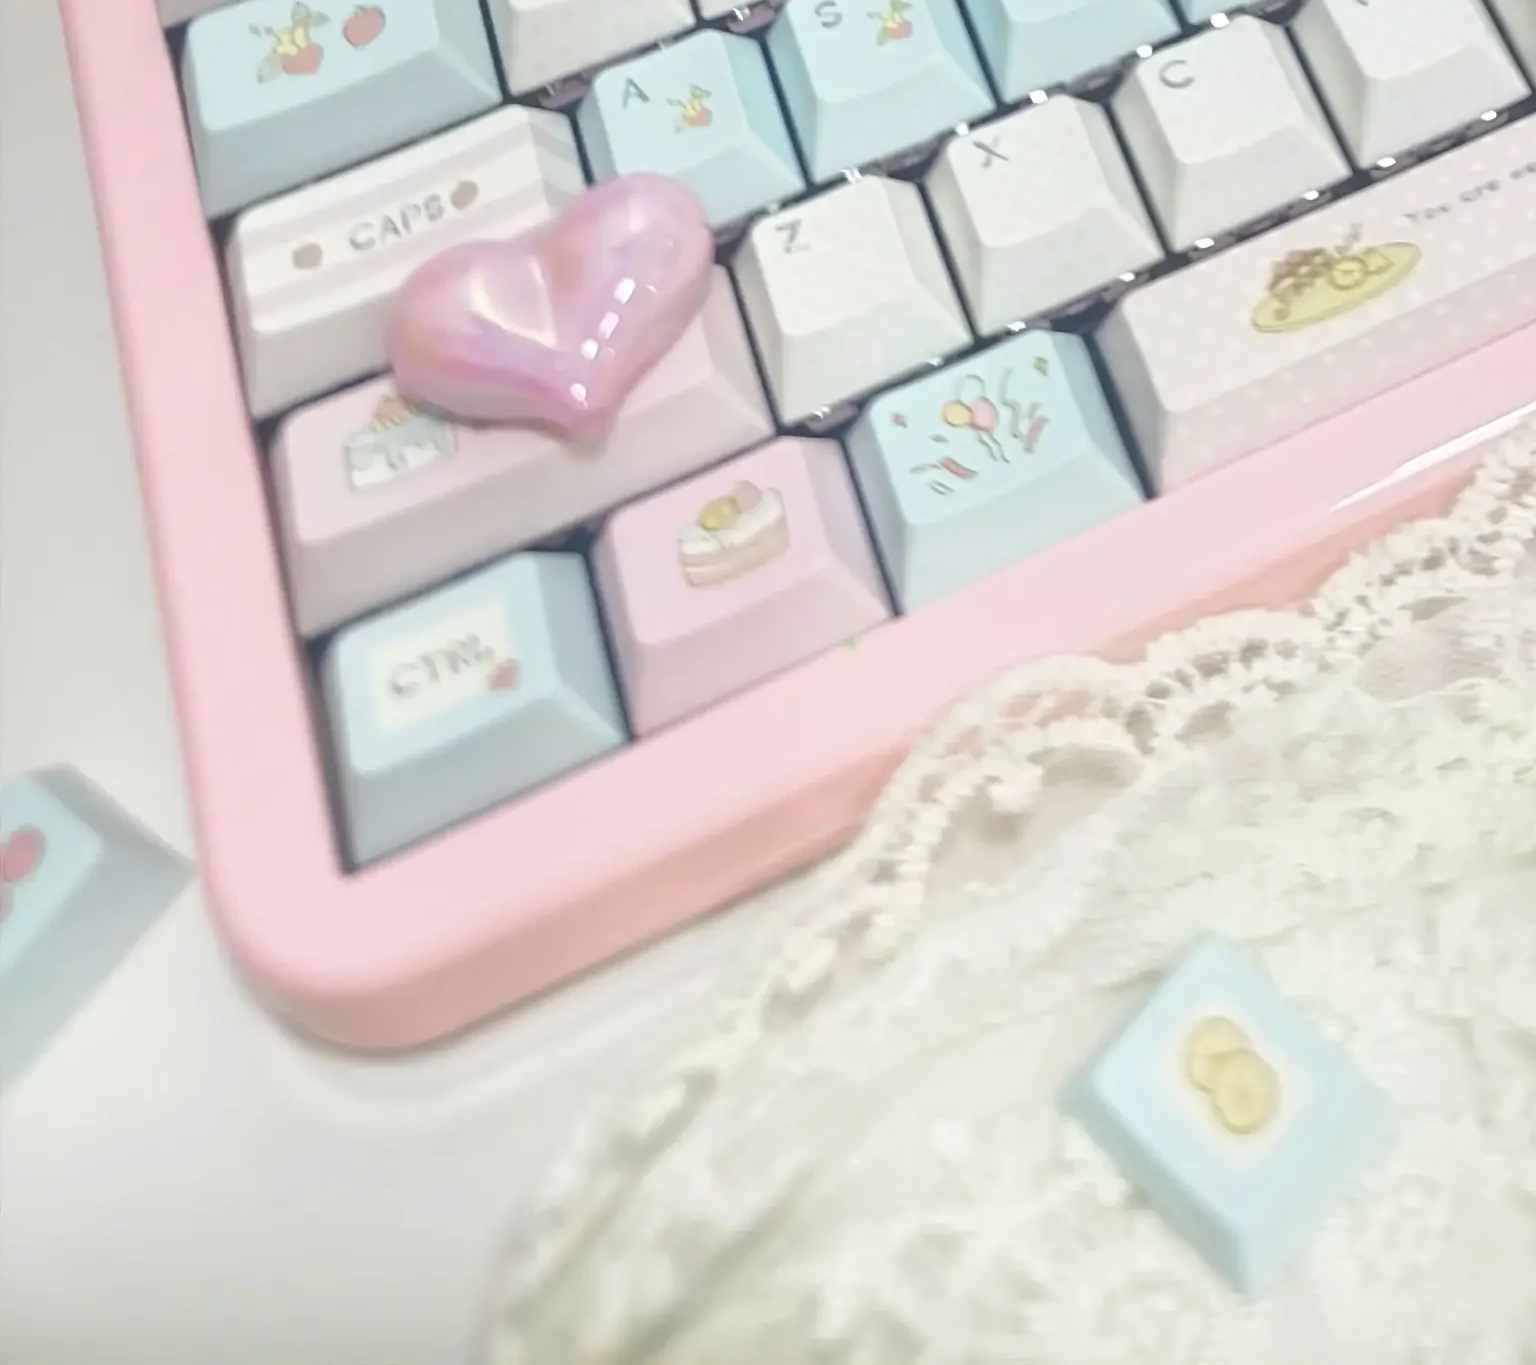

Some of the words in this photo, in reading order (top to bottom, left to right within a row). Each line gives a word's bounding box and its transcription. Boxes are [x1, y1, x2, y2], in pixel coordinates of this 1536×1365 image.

[814, 0, 843, 30] S
[1158, 59, 1195, 90] C
[622, 77, 650, 107] A
[972, 141, 1009, 169] X
[348, 194, 444, 251] CAPS
[776, 219, 805, 255] Z
